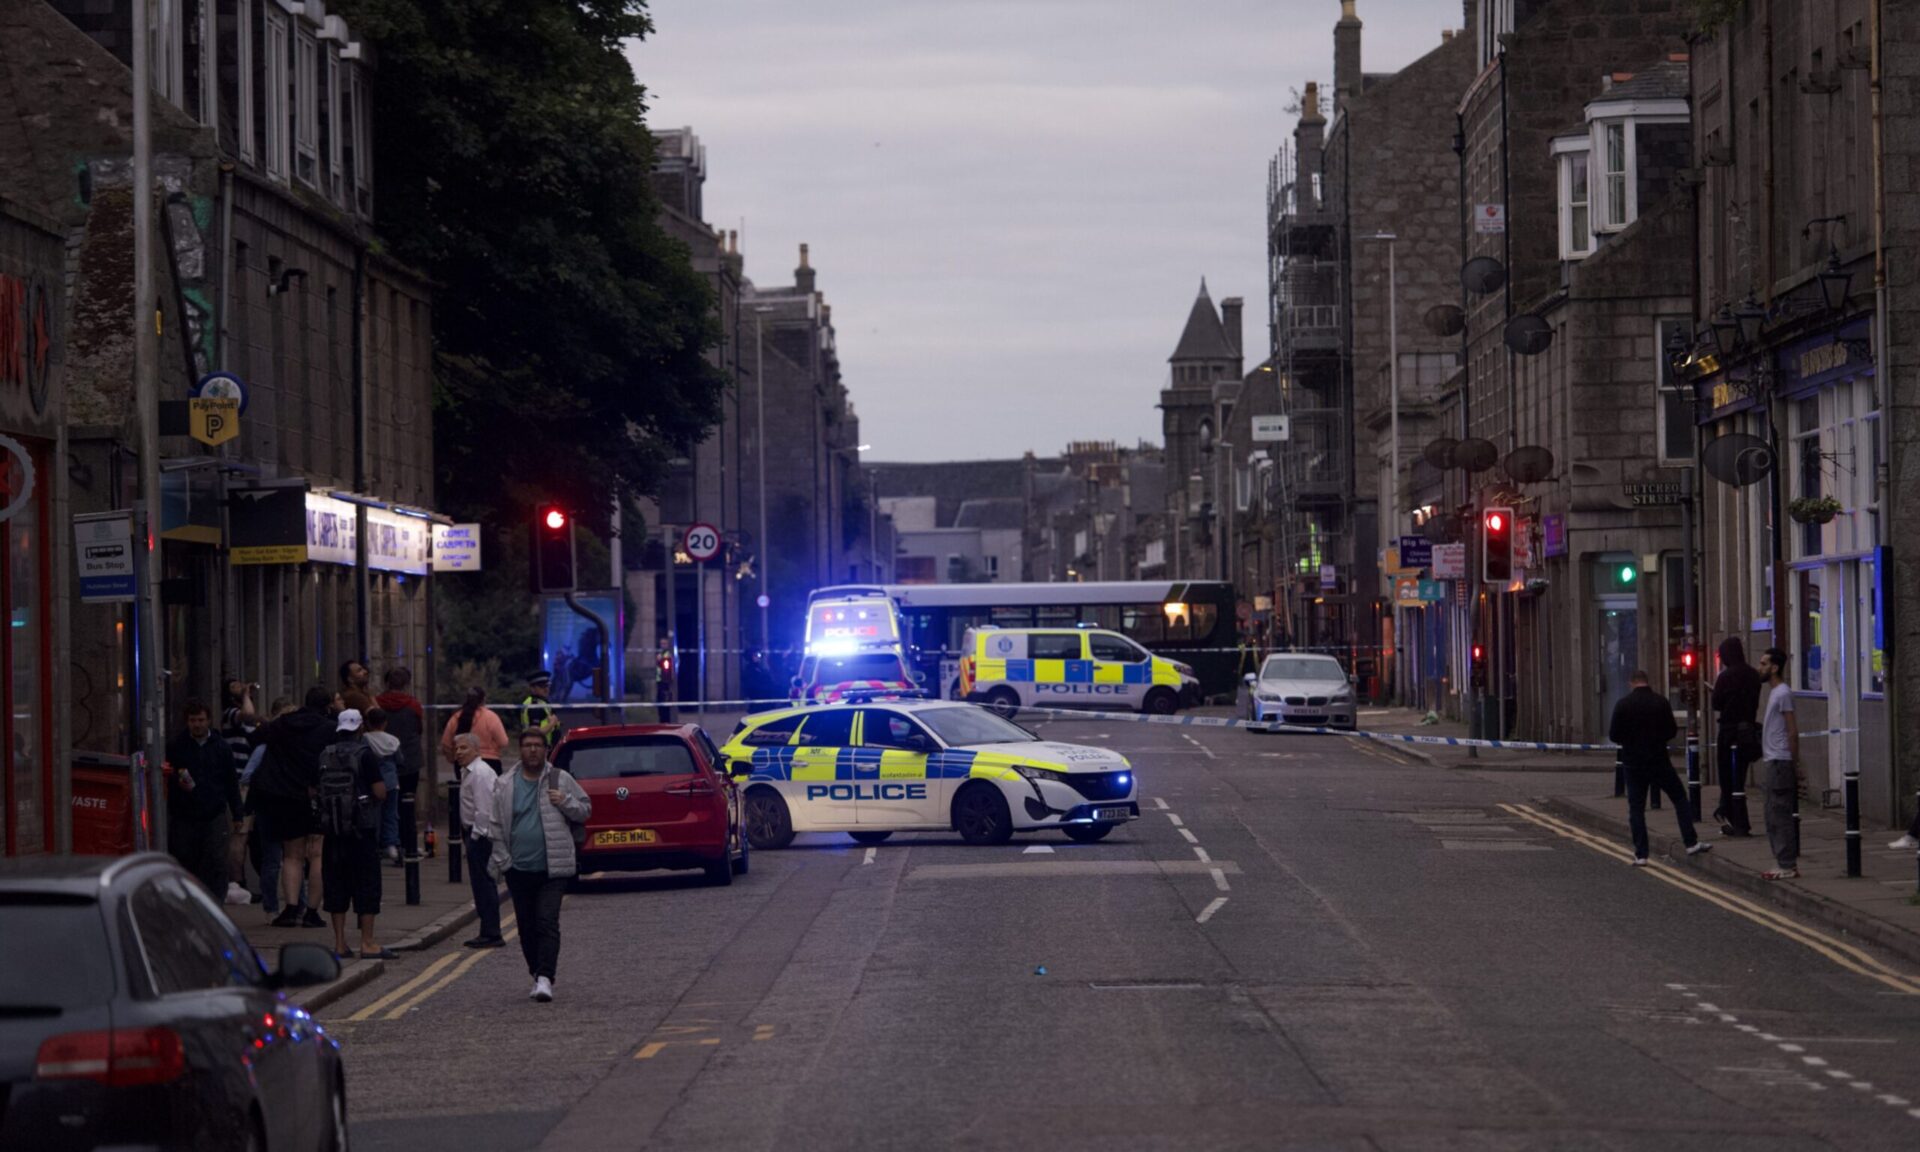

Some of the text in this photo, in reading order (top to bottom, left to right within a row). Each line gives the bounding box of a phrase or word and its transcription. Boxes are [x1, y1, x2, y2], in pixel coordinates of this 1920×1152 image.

[1624, 484, 1681, 495] HUTCHEO
[1632, 494, 1679, 505] STREET
[690, 534, 715, 550] 20
[105, 562, 125, 570] Stop
[825, 626, 878, 637] POLICE
[1035, 684, 1129, 694] POLICE
[807, 784, 927, 800] POLICE
[599, 833, 627, 843] SP66
